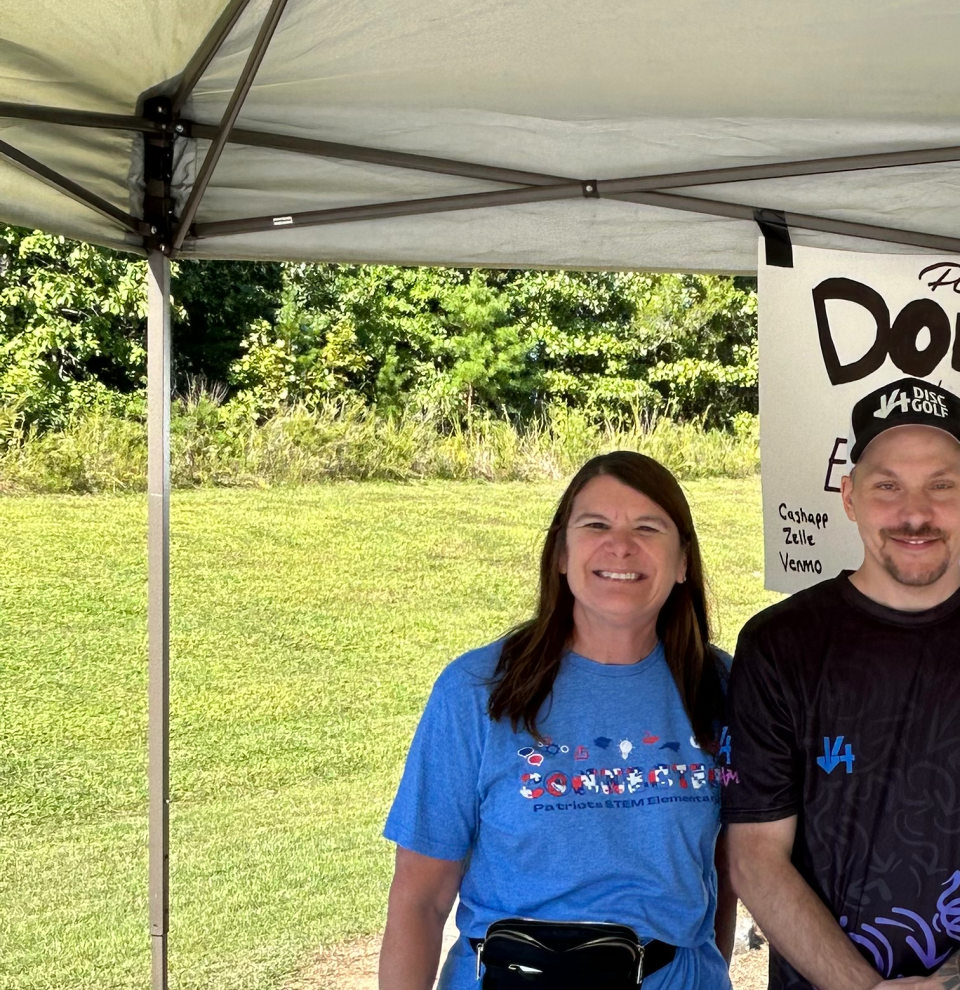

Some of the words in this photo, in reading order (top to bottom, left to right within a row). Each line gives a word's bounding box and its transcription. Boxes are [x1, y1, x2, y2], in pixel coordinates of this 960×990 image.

[912, 386, 947, 408] DISC
[911, 398, 949, 418] GOLF
[778, 503, 829, 530] Cashapp
[782, 527, 816, 546] Zelle
[779, 551, 822, 574] Venmo
[533, 800, 603, 812] Patriots
[604, 798, 644, 809] STEM
